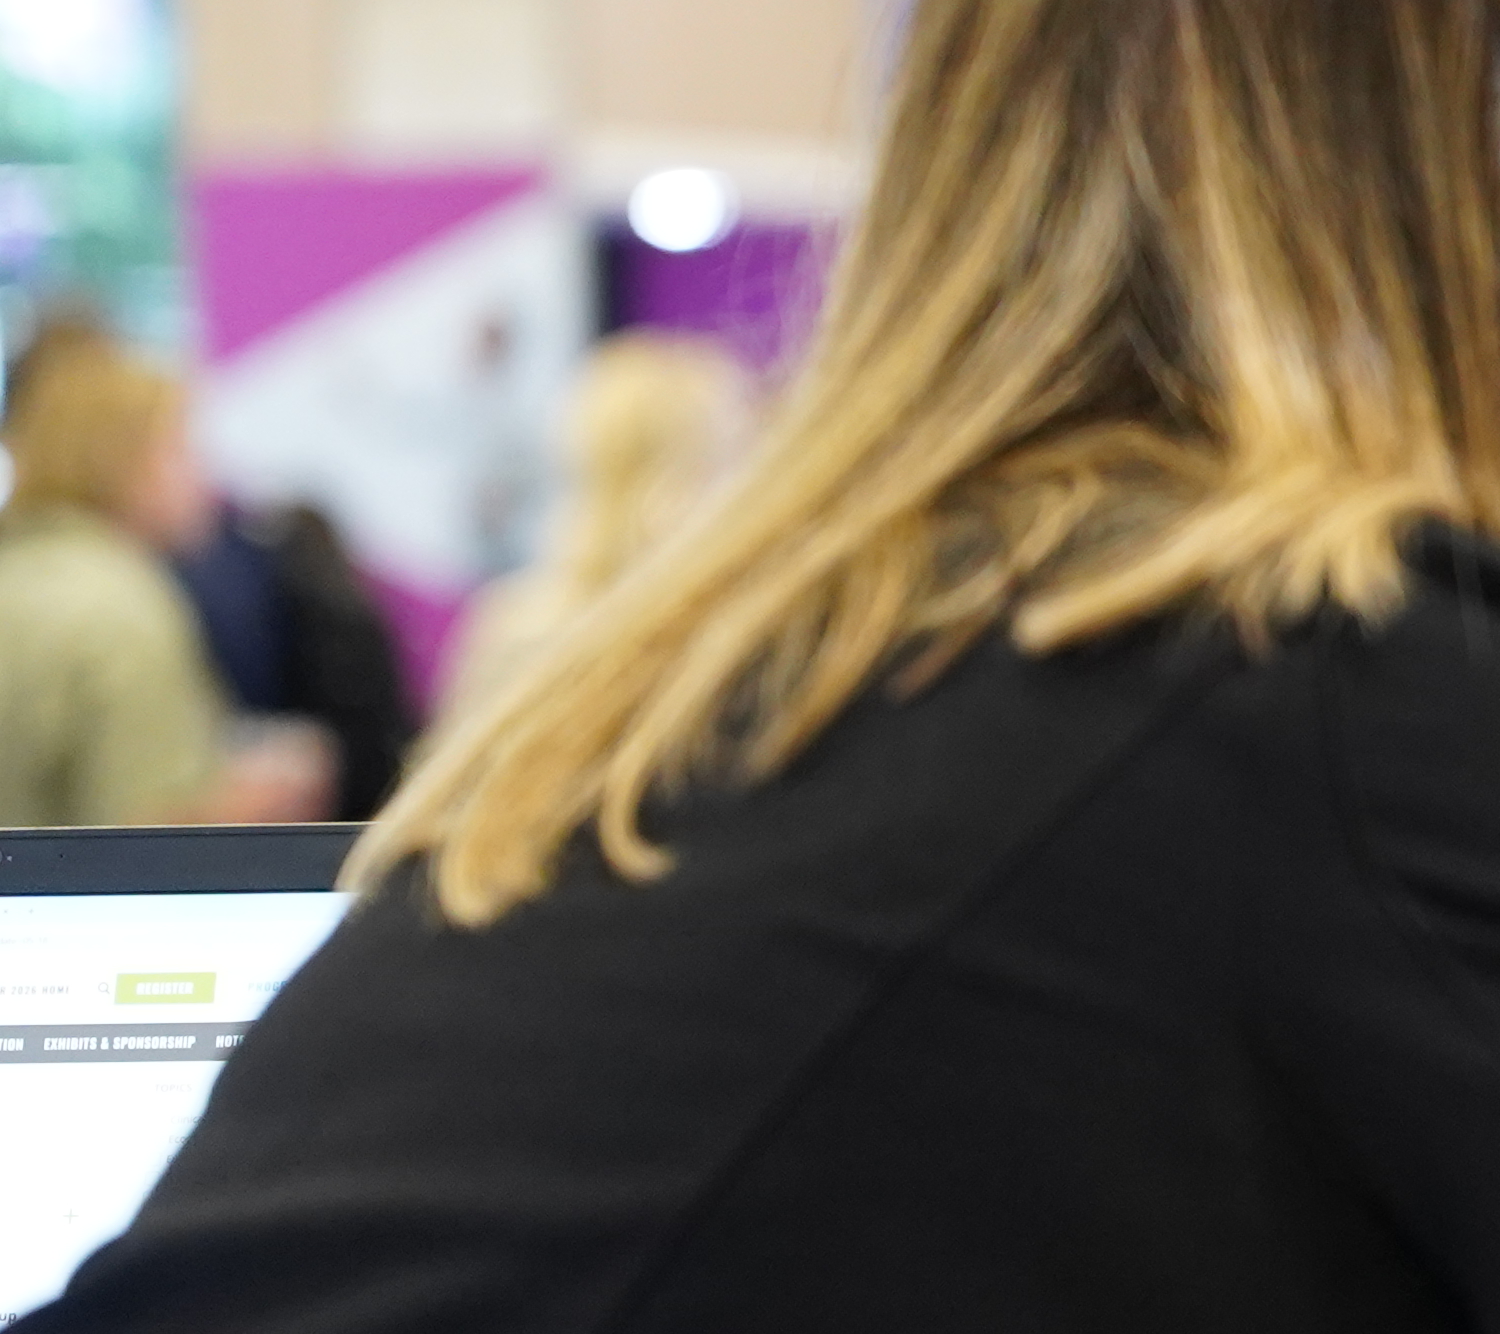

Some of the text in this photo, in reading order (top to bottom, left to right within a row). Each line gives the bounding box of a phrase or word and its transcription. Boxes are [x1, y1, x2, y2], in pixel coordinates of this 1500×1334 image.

[136, 981, 194, 996] REGISTER
[43, 1035, 197, 1051] EXHIBITS & SPONSORSHIP
